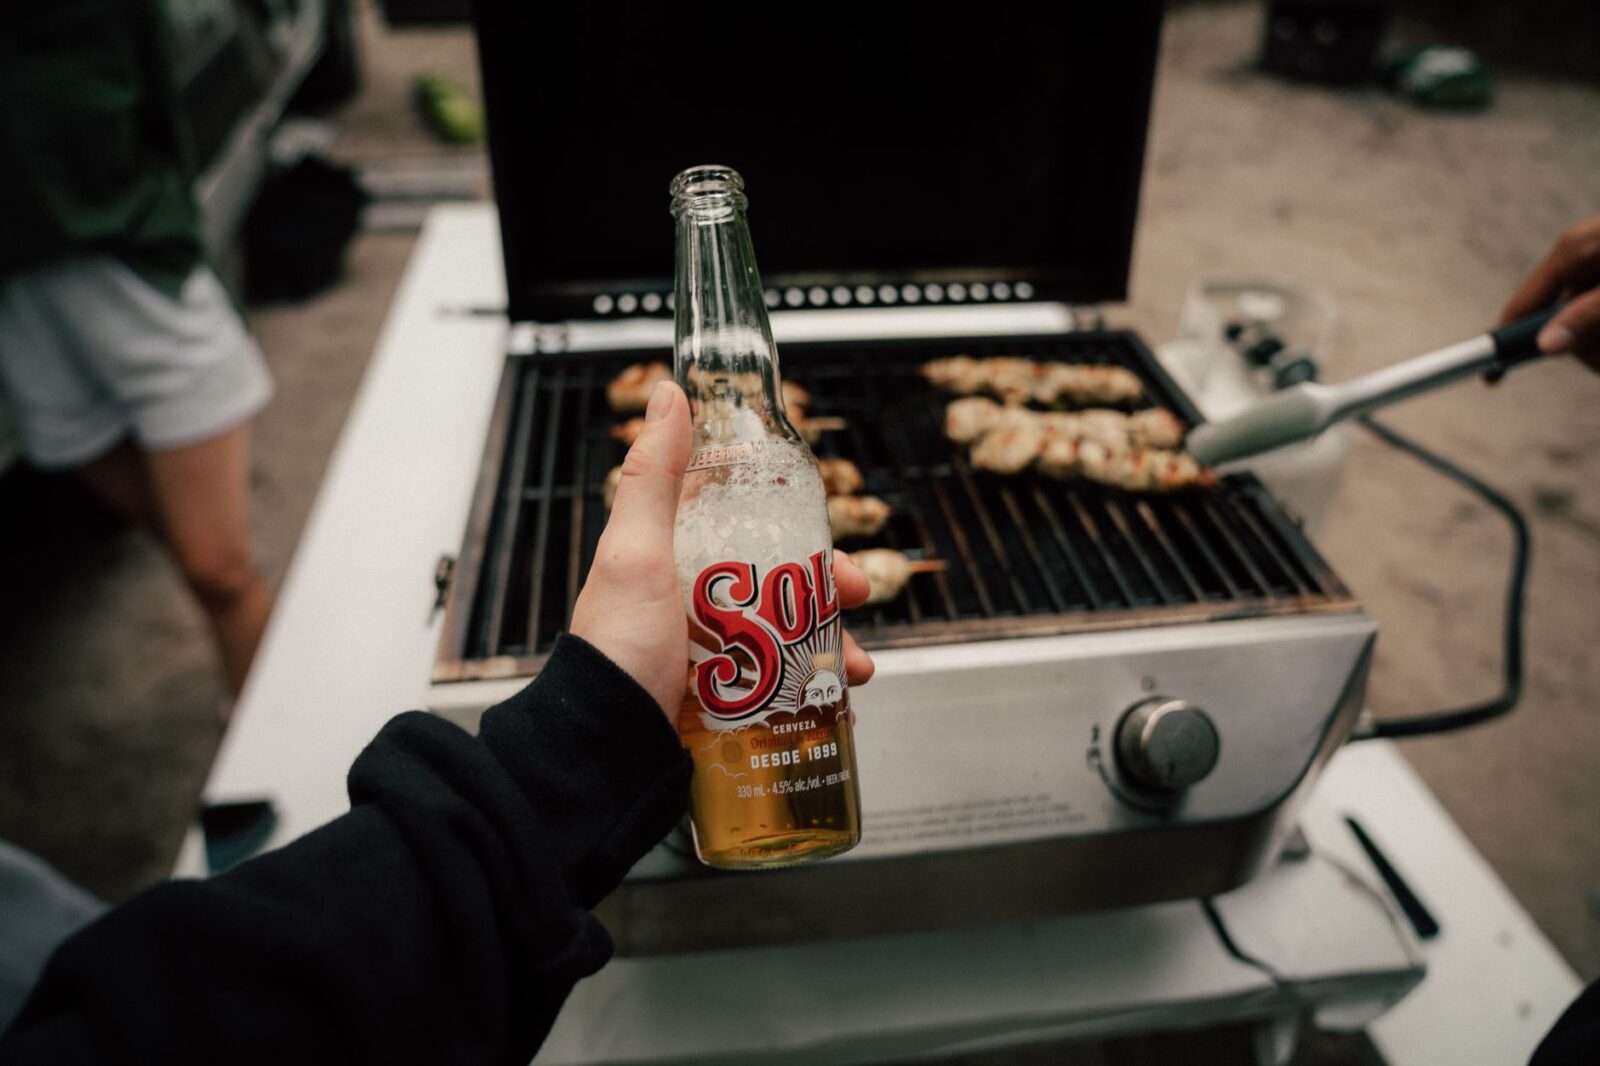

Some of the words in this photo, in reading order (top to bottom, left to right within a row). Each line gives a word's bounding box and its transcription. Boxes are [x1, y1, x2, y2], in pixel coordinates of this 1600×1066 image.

[693, 551, 840, 720] SOL
[773, 720, 816, 735] CERVEZA
[751, 750, 800, 769] DESDE
[808, 743, 837, 760] 1899
[737, 785, 752, 799] 330
[753, 784, 767, 797] mL
[772, 780, 793, 795] 4.5%
[795, 775, 821, 792] alc./vol.
